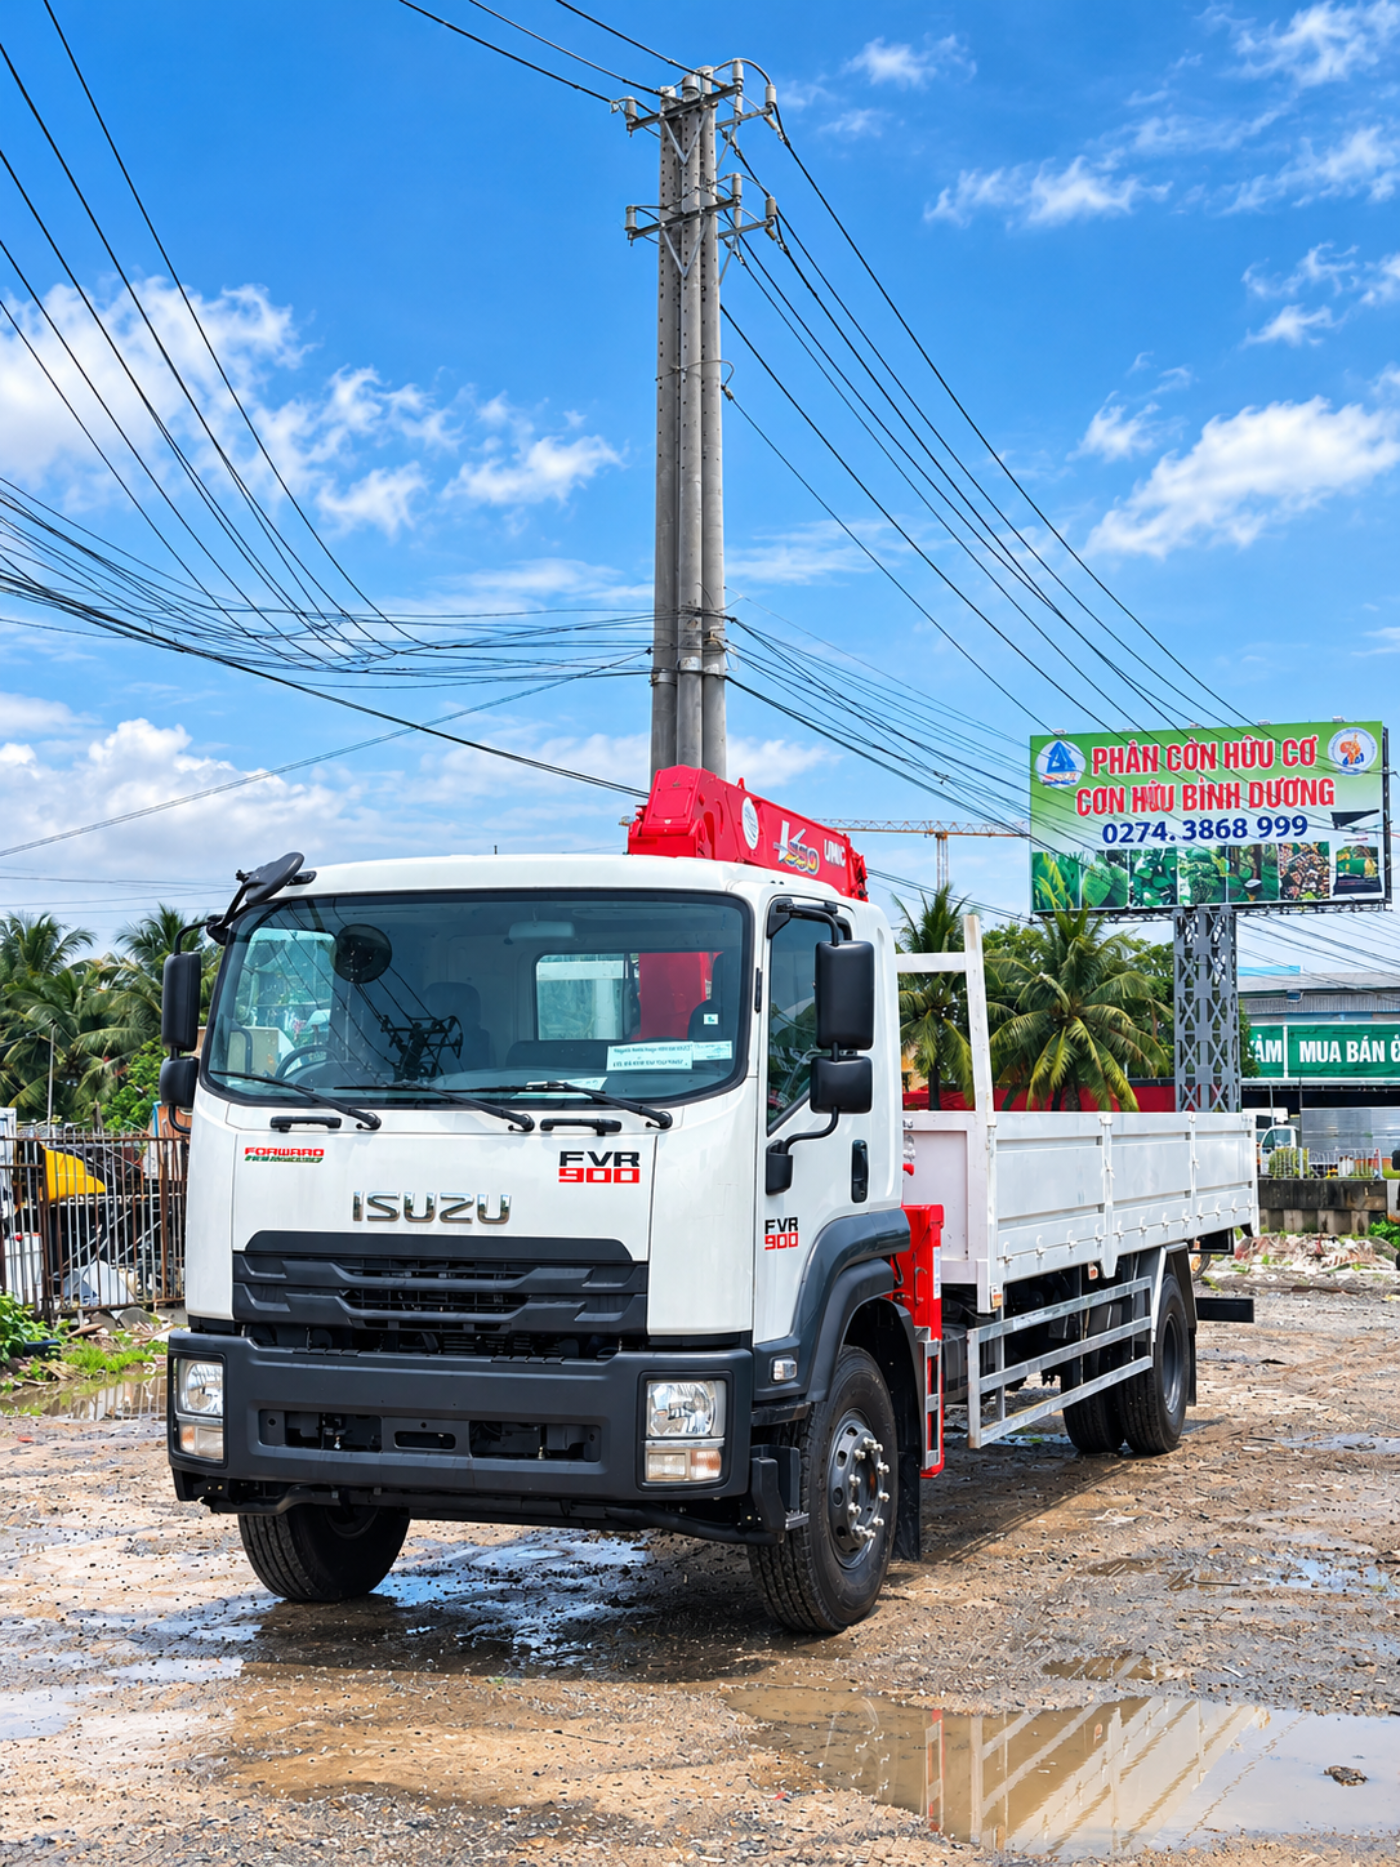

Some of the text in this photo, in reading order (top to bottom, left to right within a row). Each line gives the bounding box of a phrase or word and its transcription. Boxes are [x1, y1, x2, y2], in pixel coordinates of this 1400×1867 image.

[1249, 777, 1335, 809] DƯƠNG
[1257, 815, 1308, 838] 999
[1299, 1041, 1342, 1062] MUA
[1346, 1035, 1385, 1062] BÁN
[559, 1151, 641, 1167] FVR
[558, 1168, 640, 1183] 900
[352, 1190, 513, 1225] ISUZU
[764, 1216, 799, 1234] FVR
[764, 1232, 799, 1250] 900
